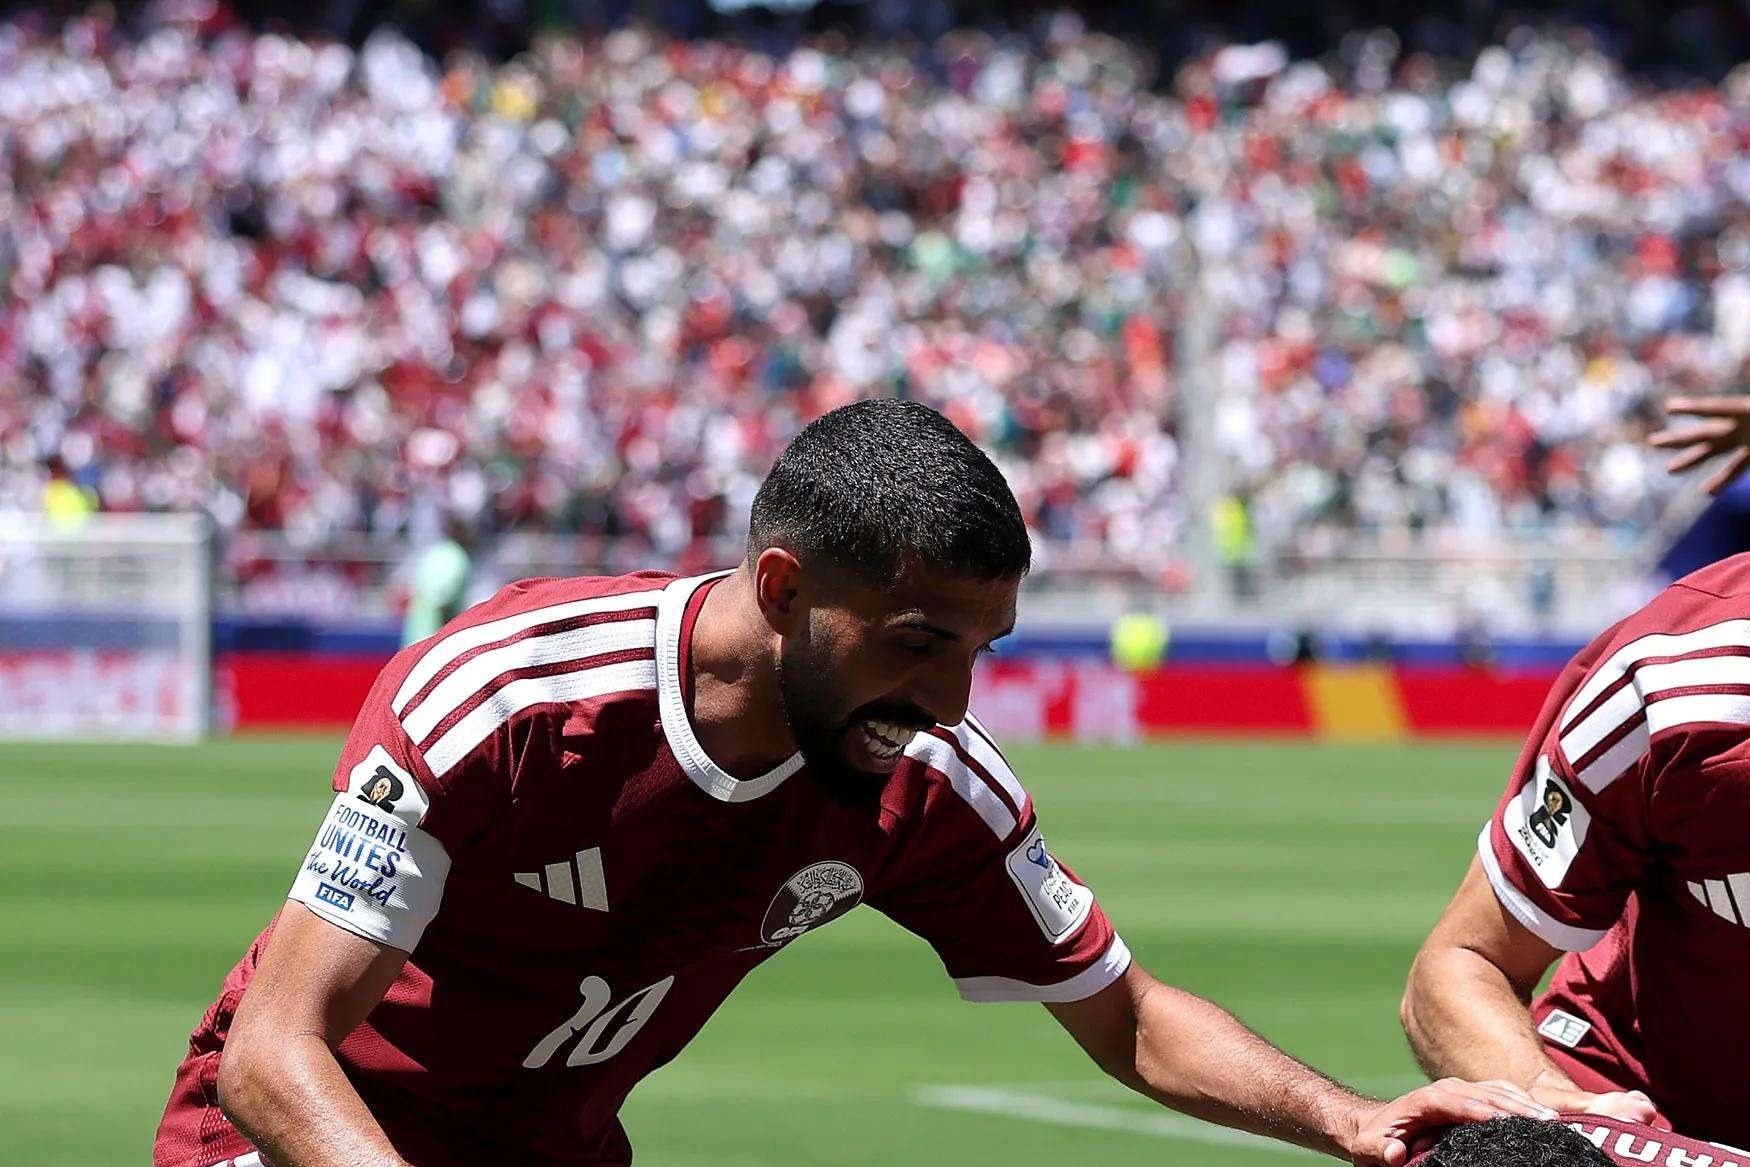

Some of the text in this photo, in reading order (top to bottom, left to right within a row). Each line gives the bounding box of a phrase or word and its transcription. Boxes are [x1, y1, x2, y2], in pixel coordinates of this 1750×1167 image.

[320, 824, 401, 878] UNITES
[335, 804, 408, 852] FOOTBALL
[307, 851, 396, 907] the World
[318, 884, 351, 908] FIFA
[522, 975, 675, 1069] 10
